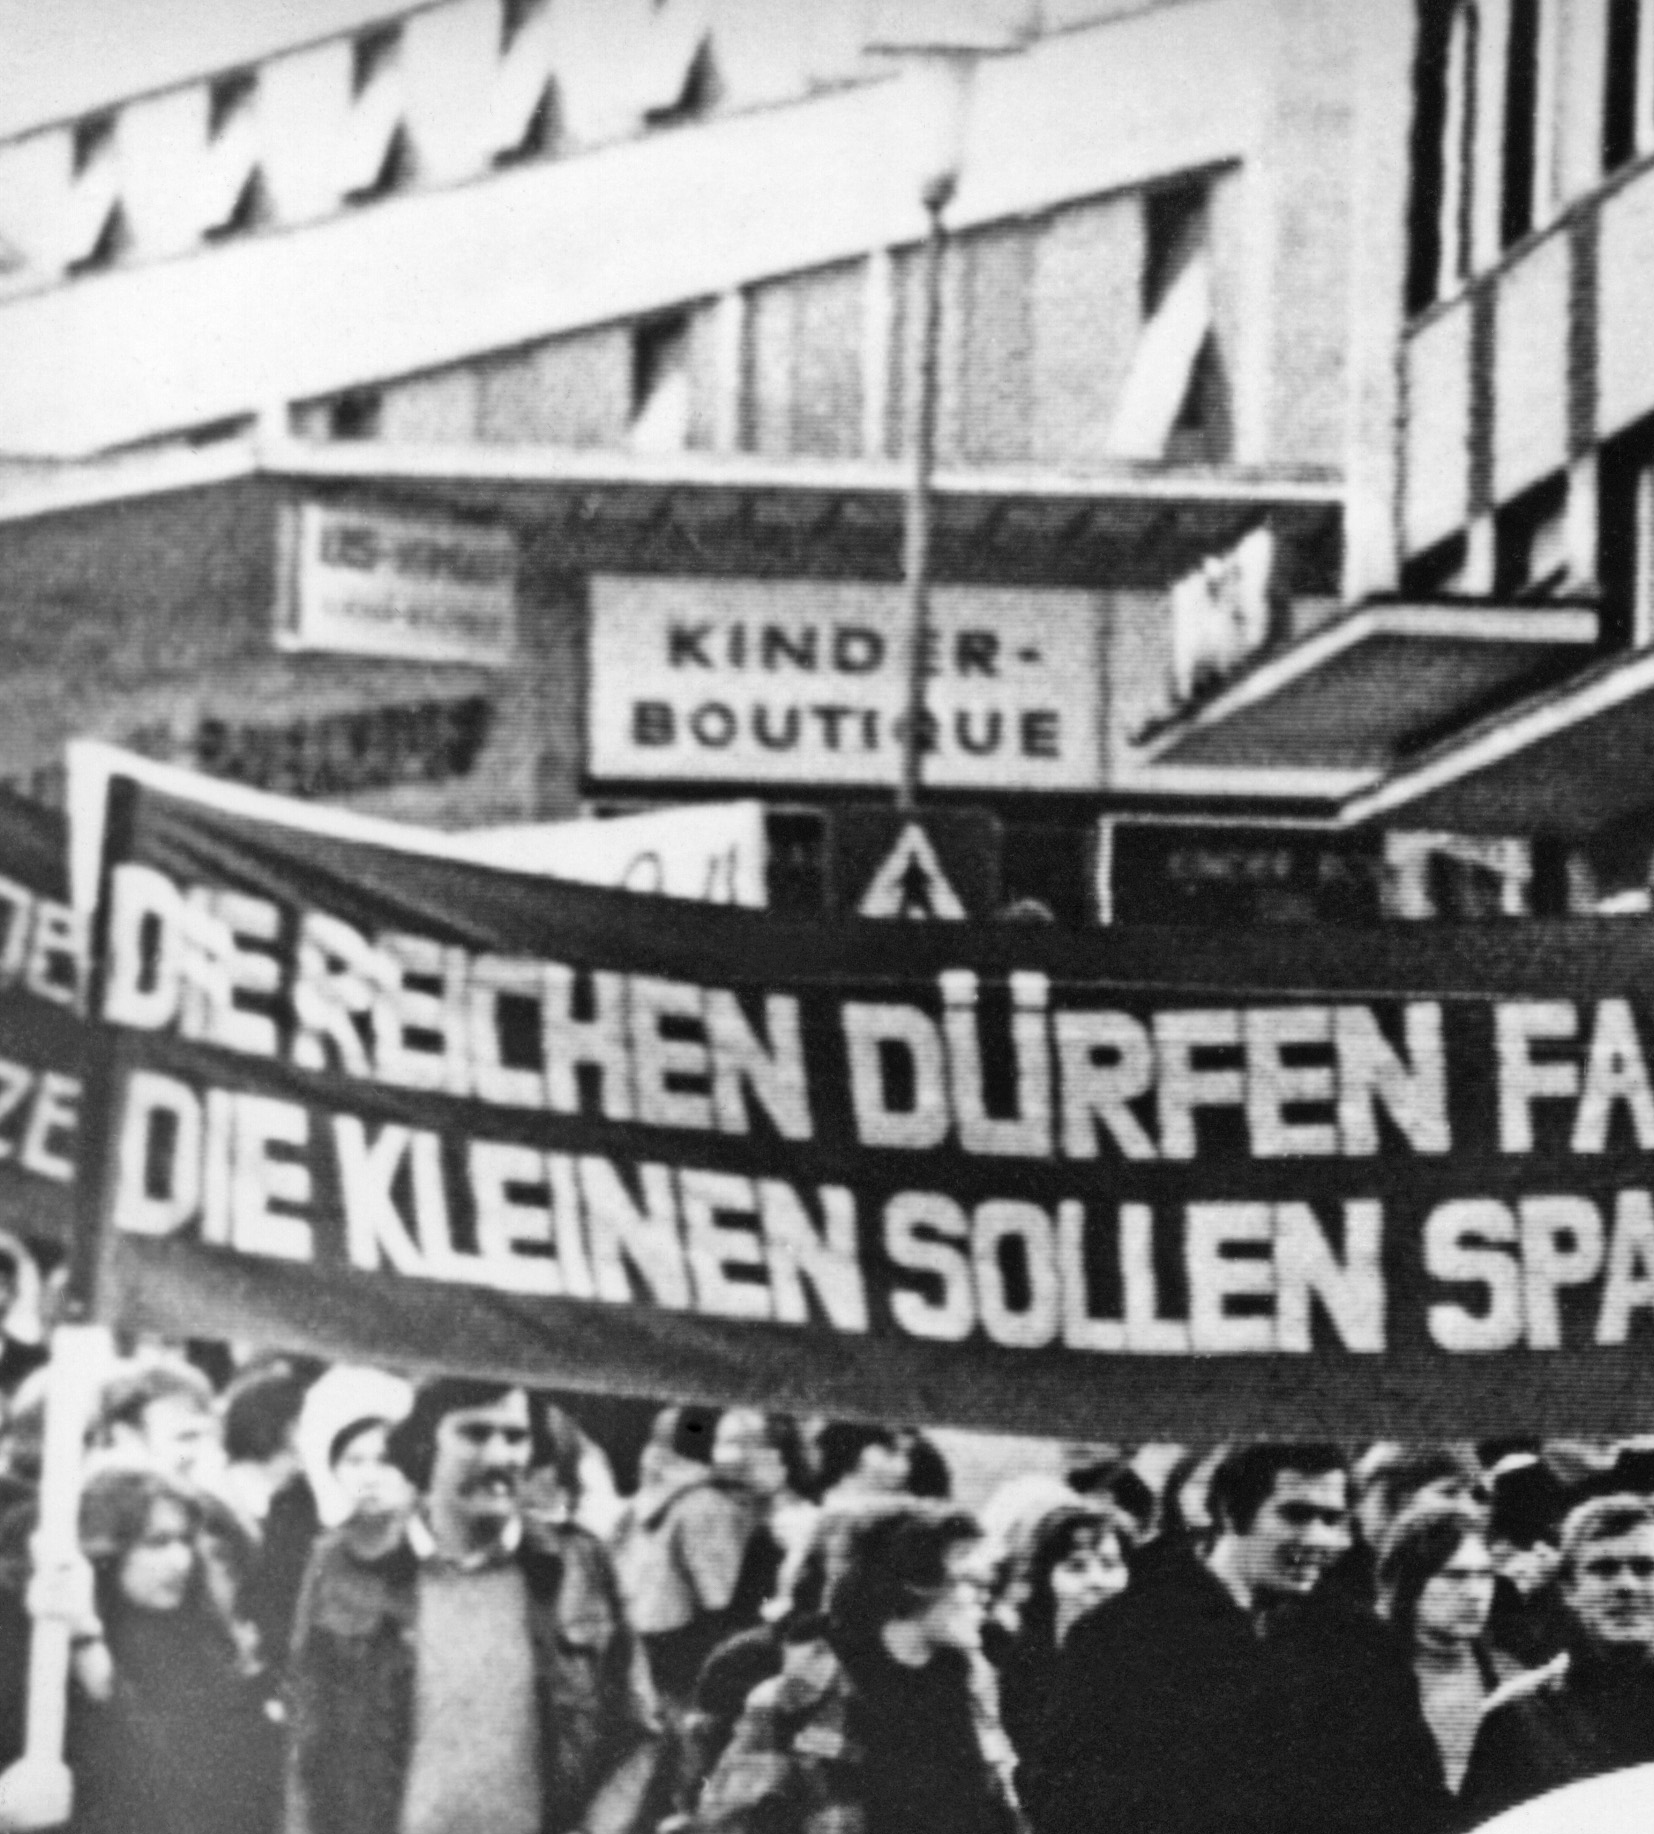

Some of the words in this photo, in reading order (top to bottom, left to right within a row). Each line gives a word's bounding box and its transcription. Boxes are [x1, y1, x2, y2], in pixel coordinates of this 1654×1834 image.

[666, 621, 1041, 678] KINDR-
[105, 862, 281, 1058] DIE
[293, 910, 813, 1141] REICHEN
[841, 969, 1451, 1160] DÜRFEN
[112, 1070, 314, 1261] DIE
[332, 1114, 869, 1334] KLEINEN
[884, 1190, 1387, 1357] SOLLEN
